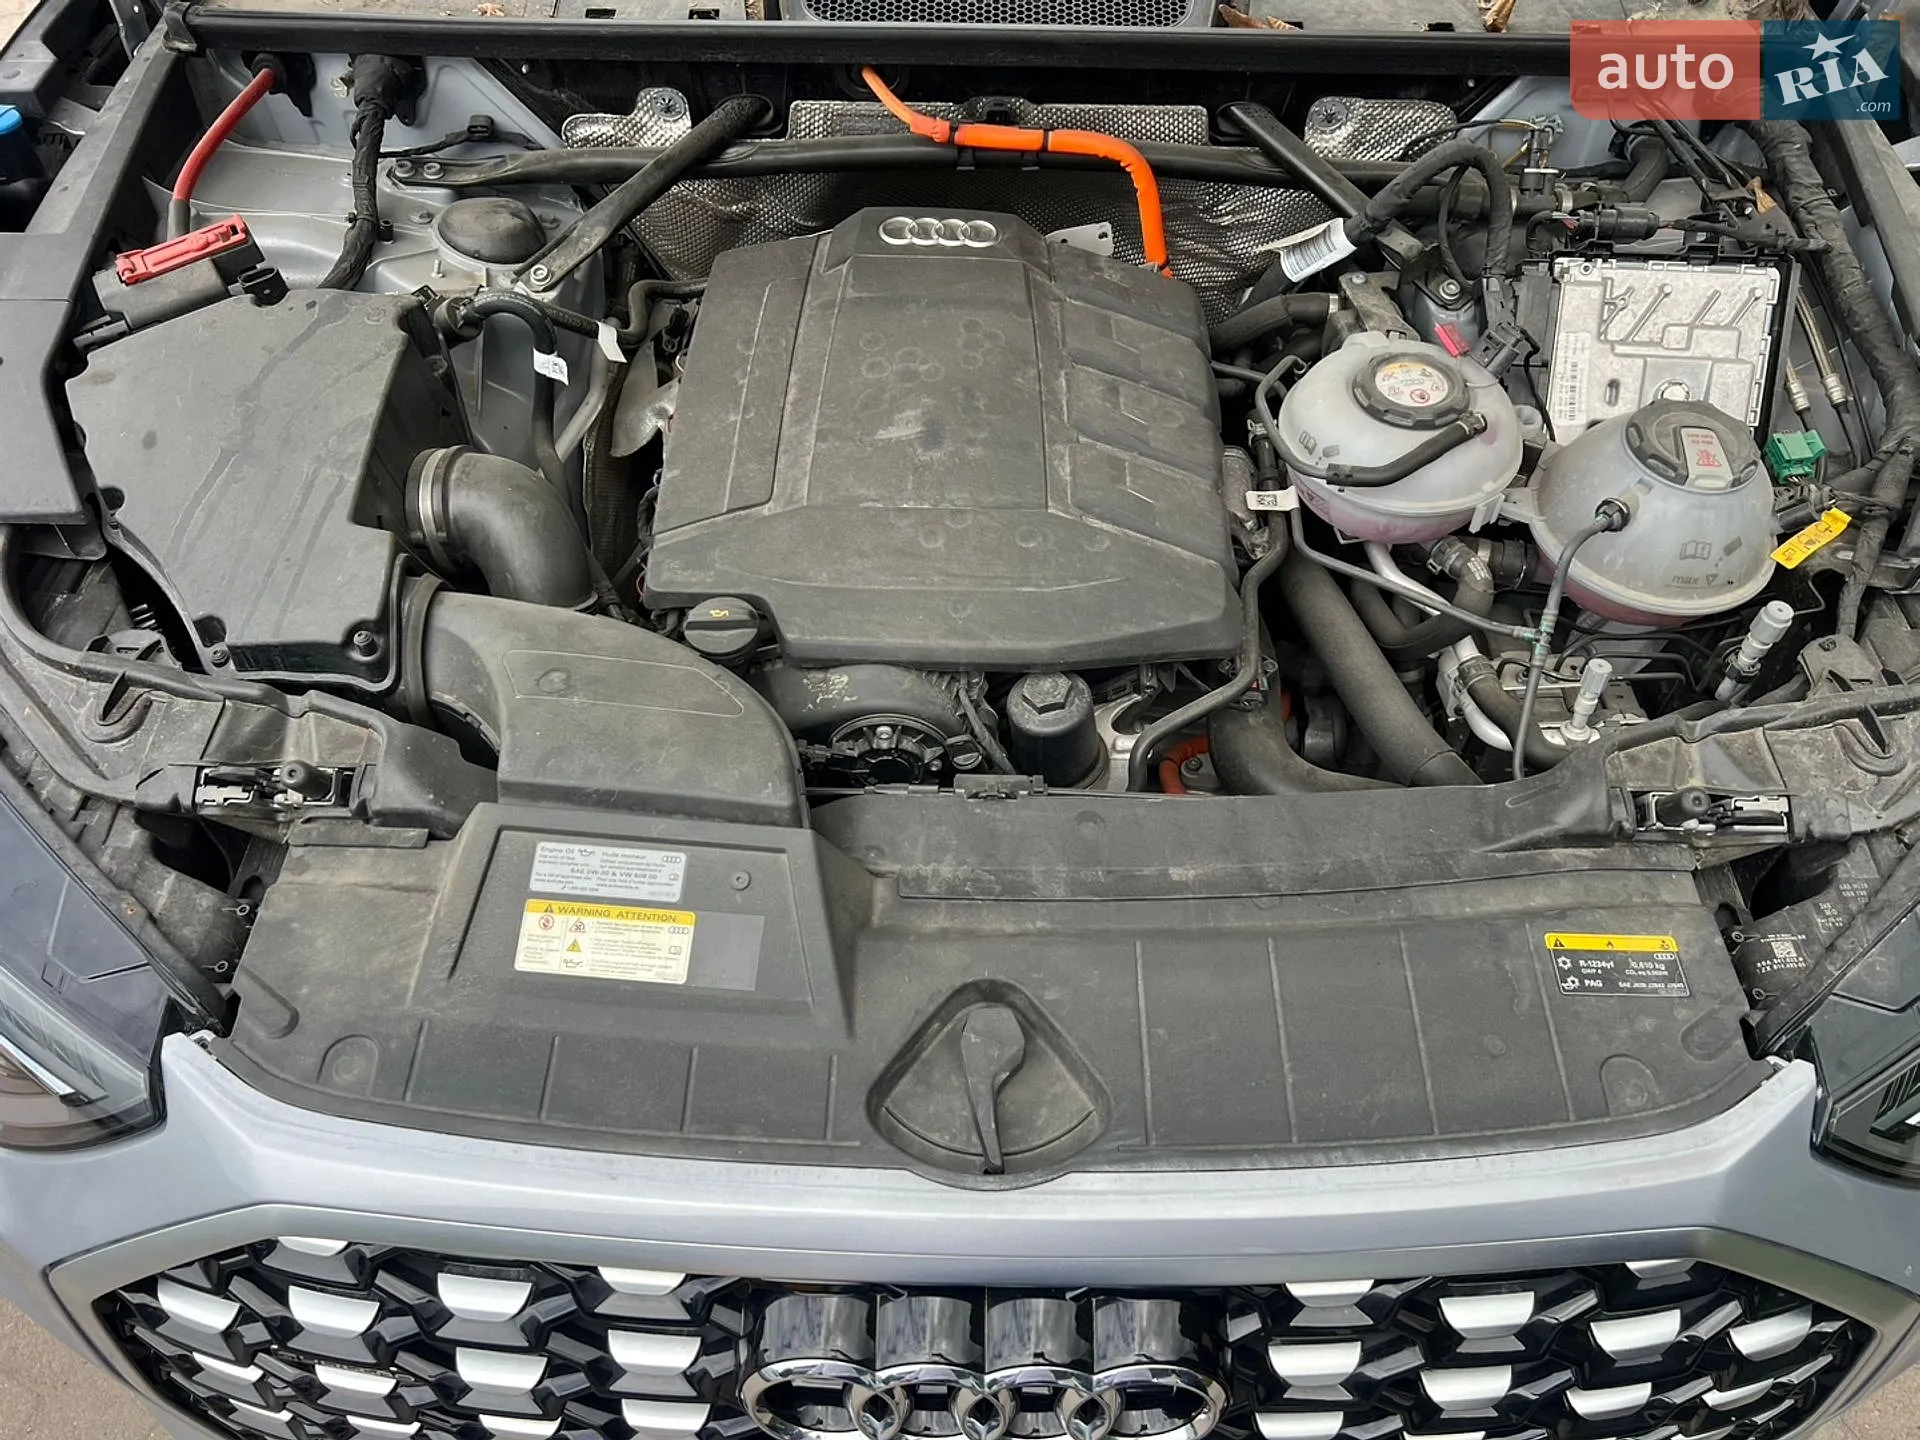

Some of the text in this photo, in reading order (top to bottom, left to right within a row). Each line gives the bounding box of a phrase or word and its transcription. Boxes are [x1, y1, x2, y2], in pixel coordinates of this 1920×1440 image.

[1672, 575, 1699, 585] max
[540, 846, 563, 854] Engine
[558, 906, 677, 922] WARNING ATTENTION
[1579, 960, 1614, 969] R-1234yf
